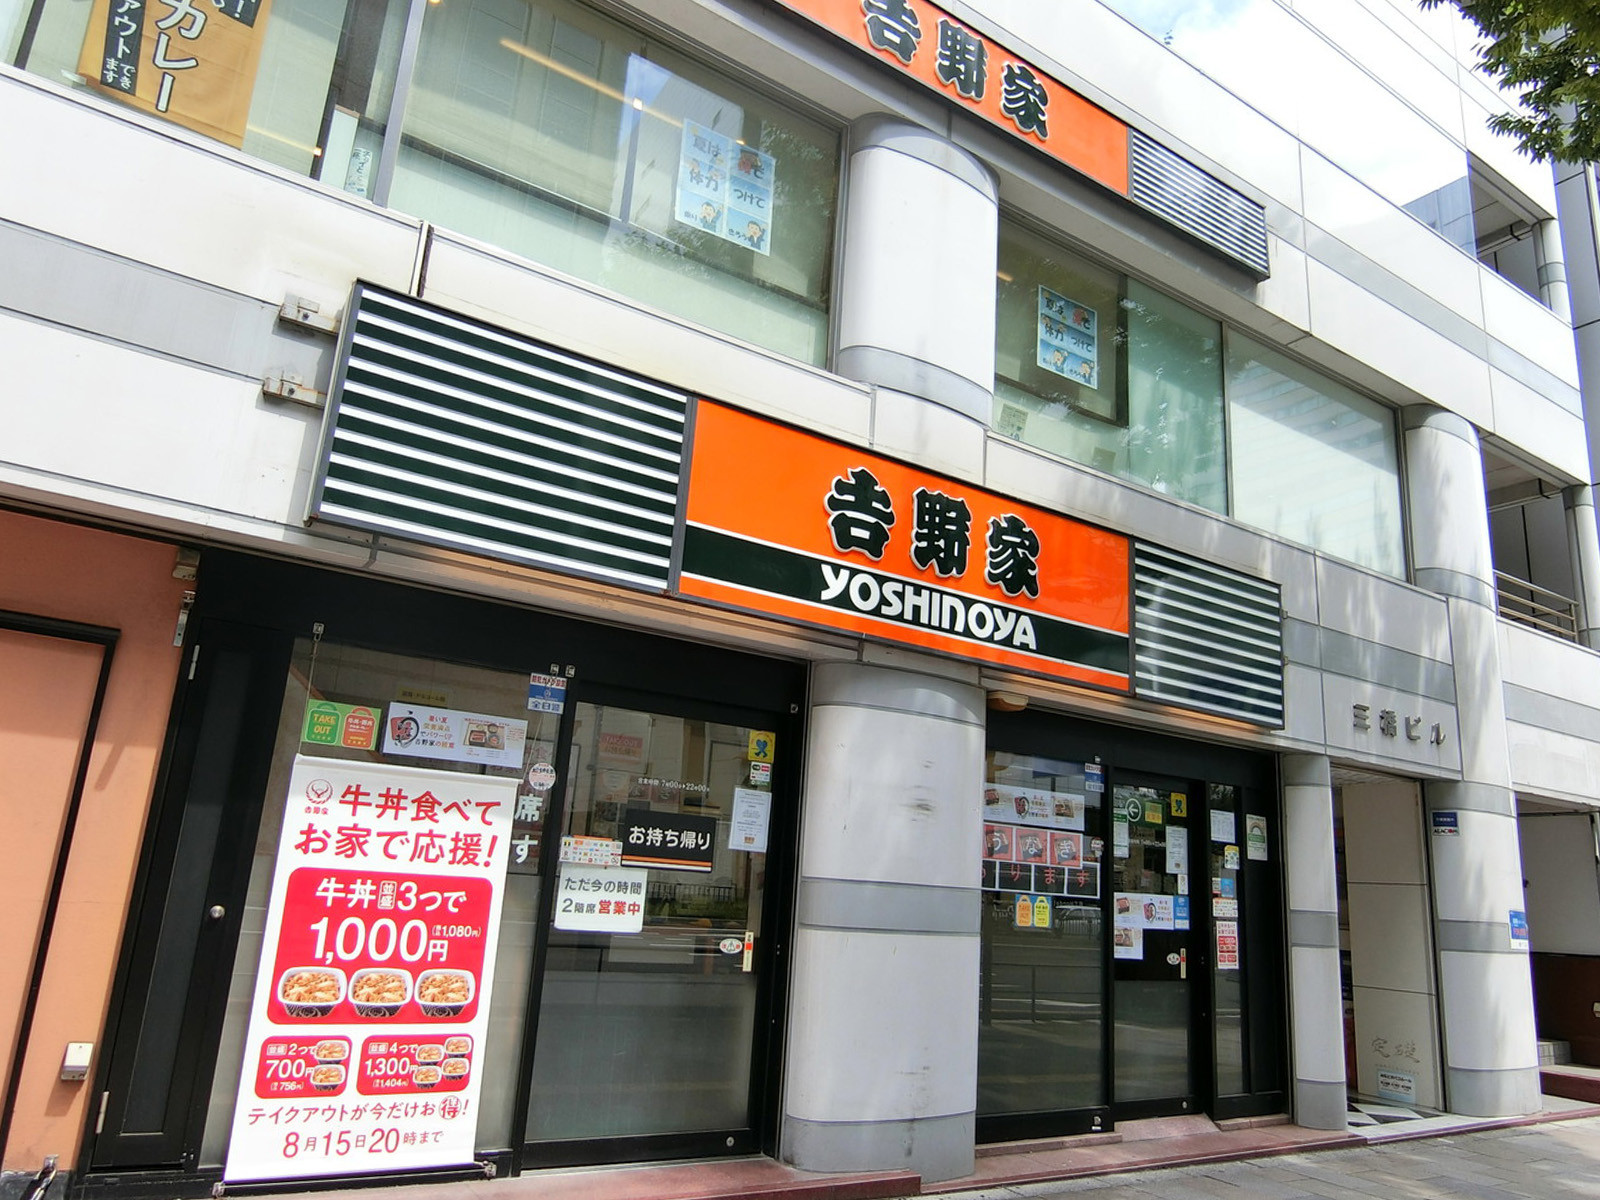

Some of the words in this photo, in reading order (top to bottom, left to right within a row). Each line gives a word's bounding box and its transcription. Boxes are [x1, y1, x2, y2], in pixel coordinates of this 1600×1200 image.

[153, 0, 207, 112] カレー
[733, 188, 765, 209] つけて
[824, 467, 1040, 600] 吉野家
[820, 564, 1037, 650] YOSHINOYA
[314, 713, 336, 724] TAKE
[314, 725, 332, 734] OUT
[1353, 703, 1446, 745] 三橋ビル
[339, 784, 501, 826] 牛丼食べて
[629, 825, 711, 851] お持ち帰り
[564, 877, 642, 895] ただ今の時間
[310, 916, 448, 964] 1,000円
[283, 1128, 443, 1159] 8月15日20時まで
